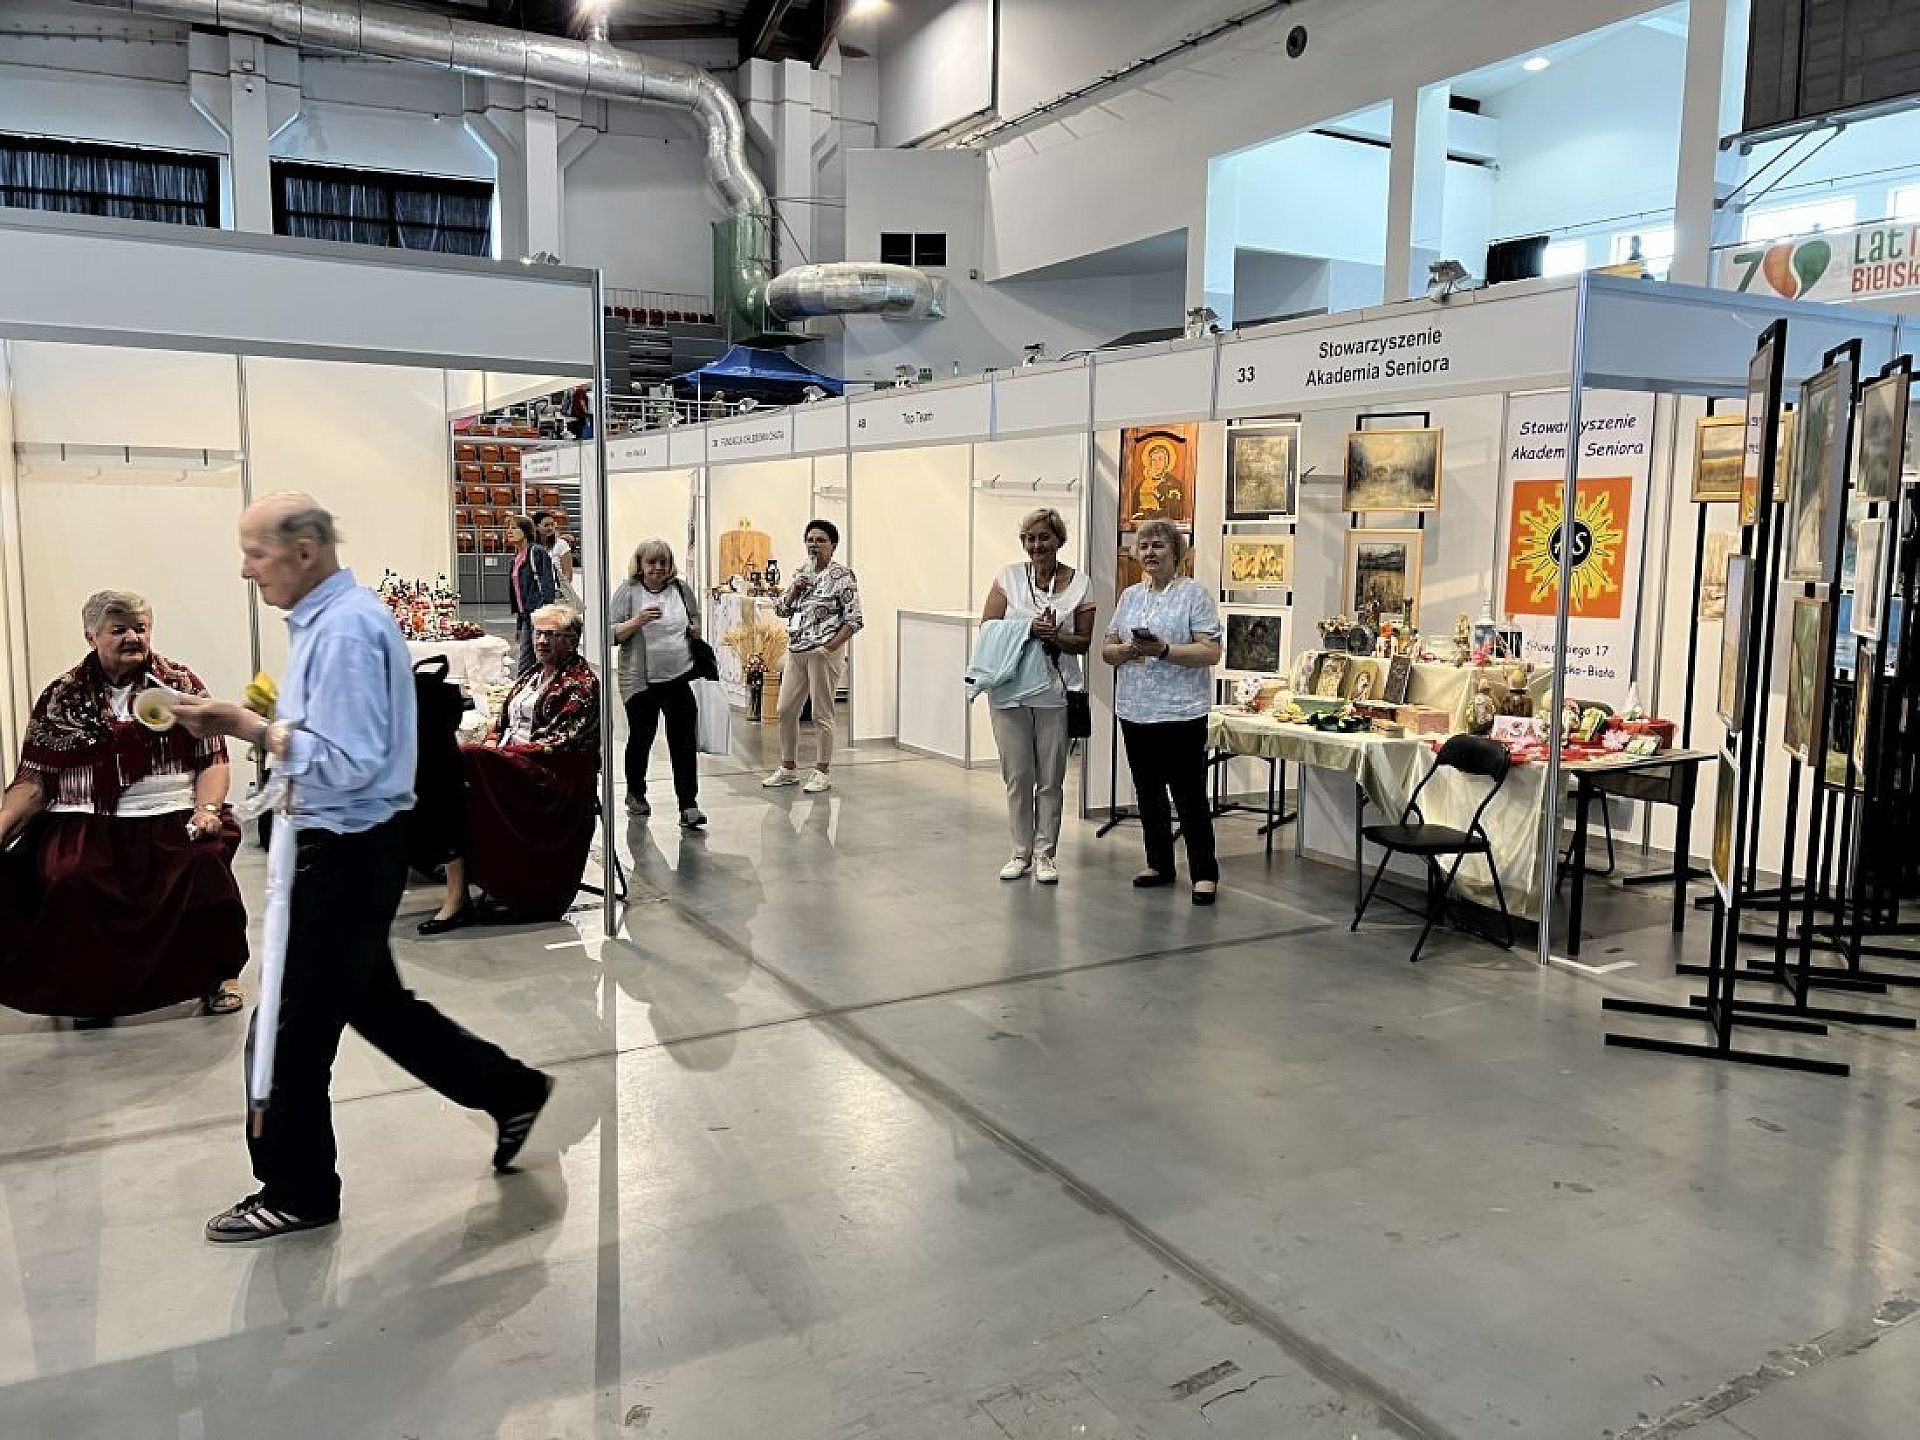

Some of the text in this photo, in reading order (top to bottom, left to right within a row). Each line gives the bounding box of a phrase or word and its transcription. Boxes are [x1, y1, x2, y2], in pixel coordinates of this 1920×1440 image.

[1319, 327, 1442, 359] Stowarzyszenie
[1237, 366, 1256, 383] 33
[1305, 356, 1450, 387] Akademia Seniora
[1519, 413, 1637, 436] Stowaryszenie
[1511, 441, 1643, 460] Akadem Seniora
[1595, 645, 1609, 657] 17
